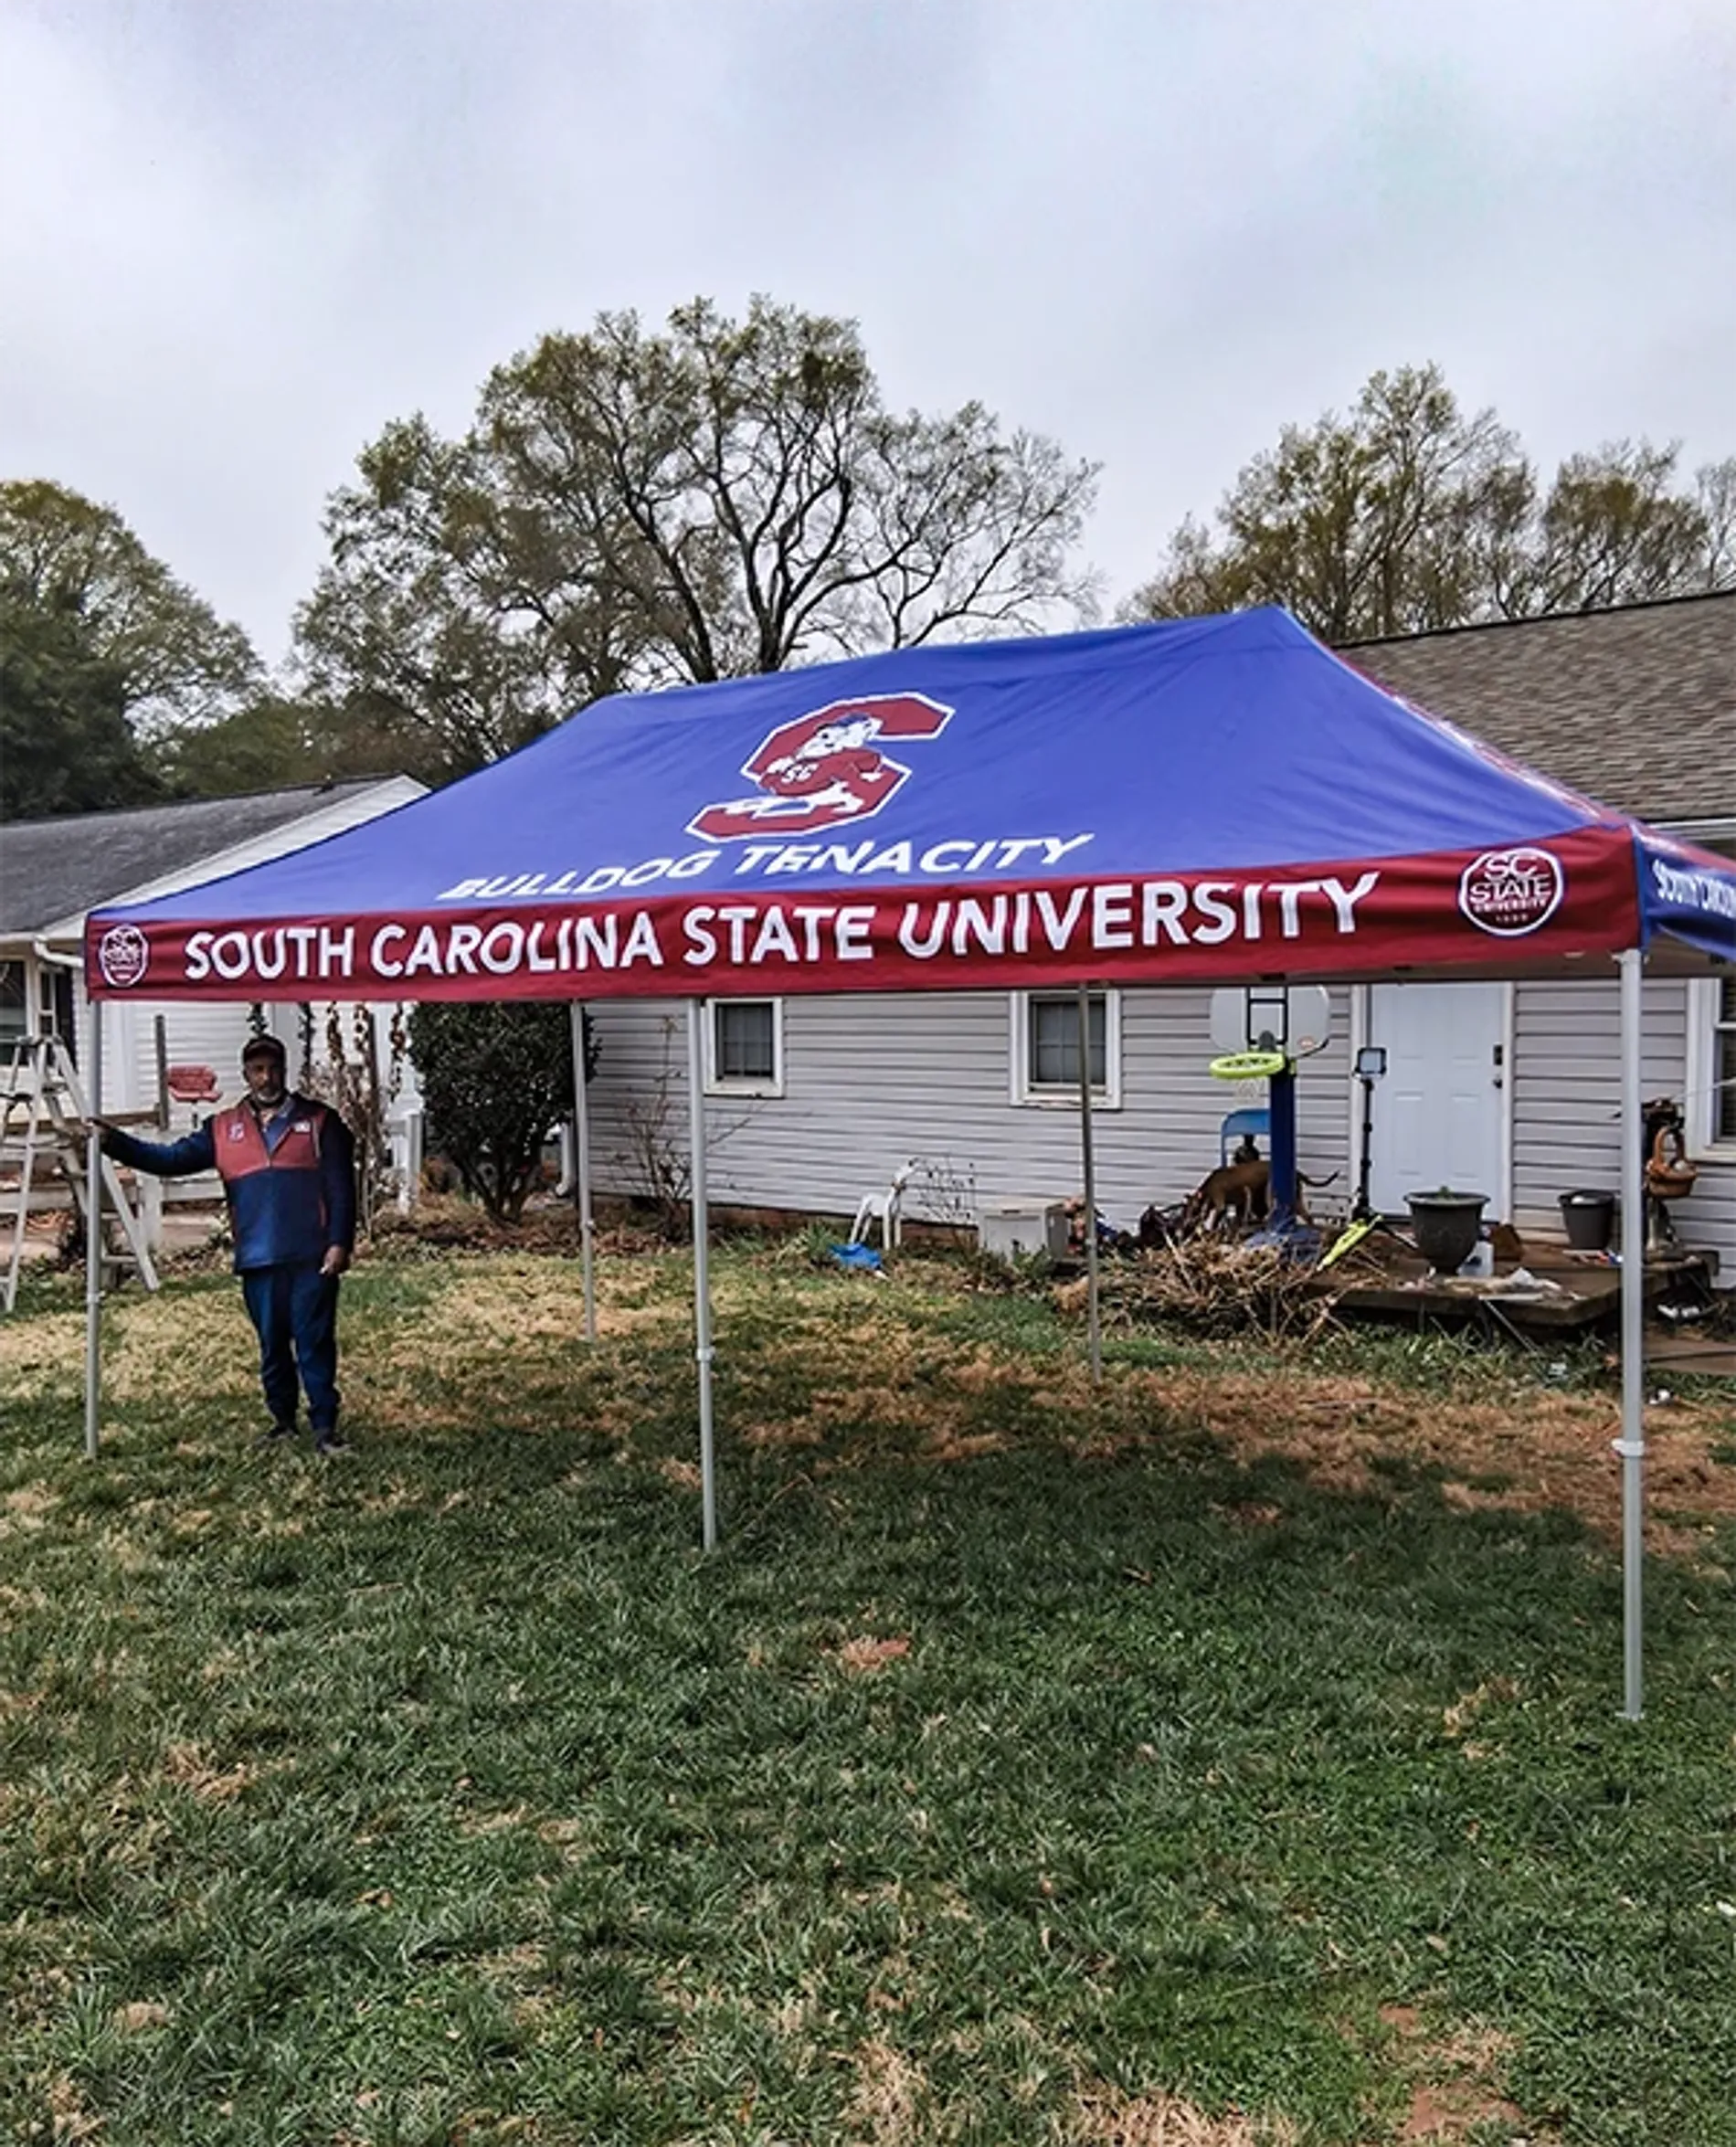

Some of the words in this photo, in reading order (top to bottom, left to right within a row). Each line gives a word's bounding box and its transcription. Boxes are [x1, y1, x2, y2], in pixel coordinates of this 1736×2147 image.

[436, 850, 722, 901] BULLDOG
[734, 832, 1096, 875] TENACITY
[1469, 873, 1551, 904] STATE
[1484, 853, 1539, 880] SC
[185, 927, 355, 978] SOUTH
[371, 912, 663, 977] CAROLINA
[683, 905, 876, 965] STATE
[899, 871, 1379, 957] UNIVERSITY
